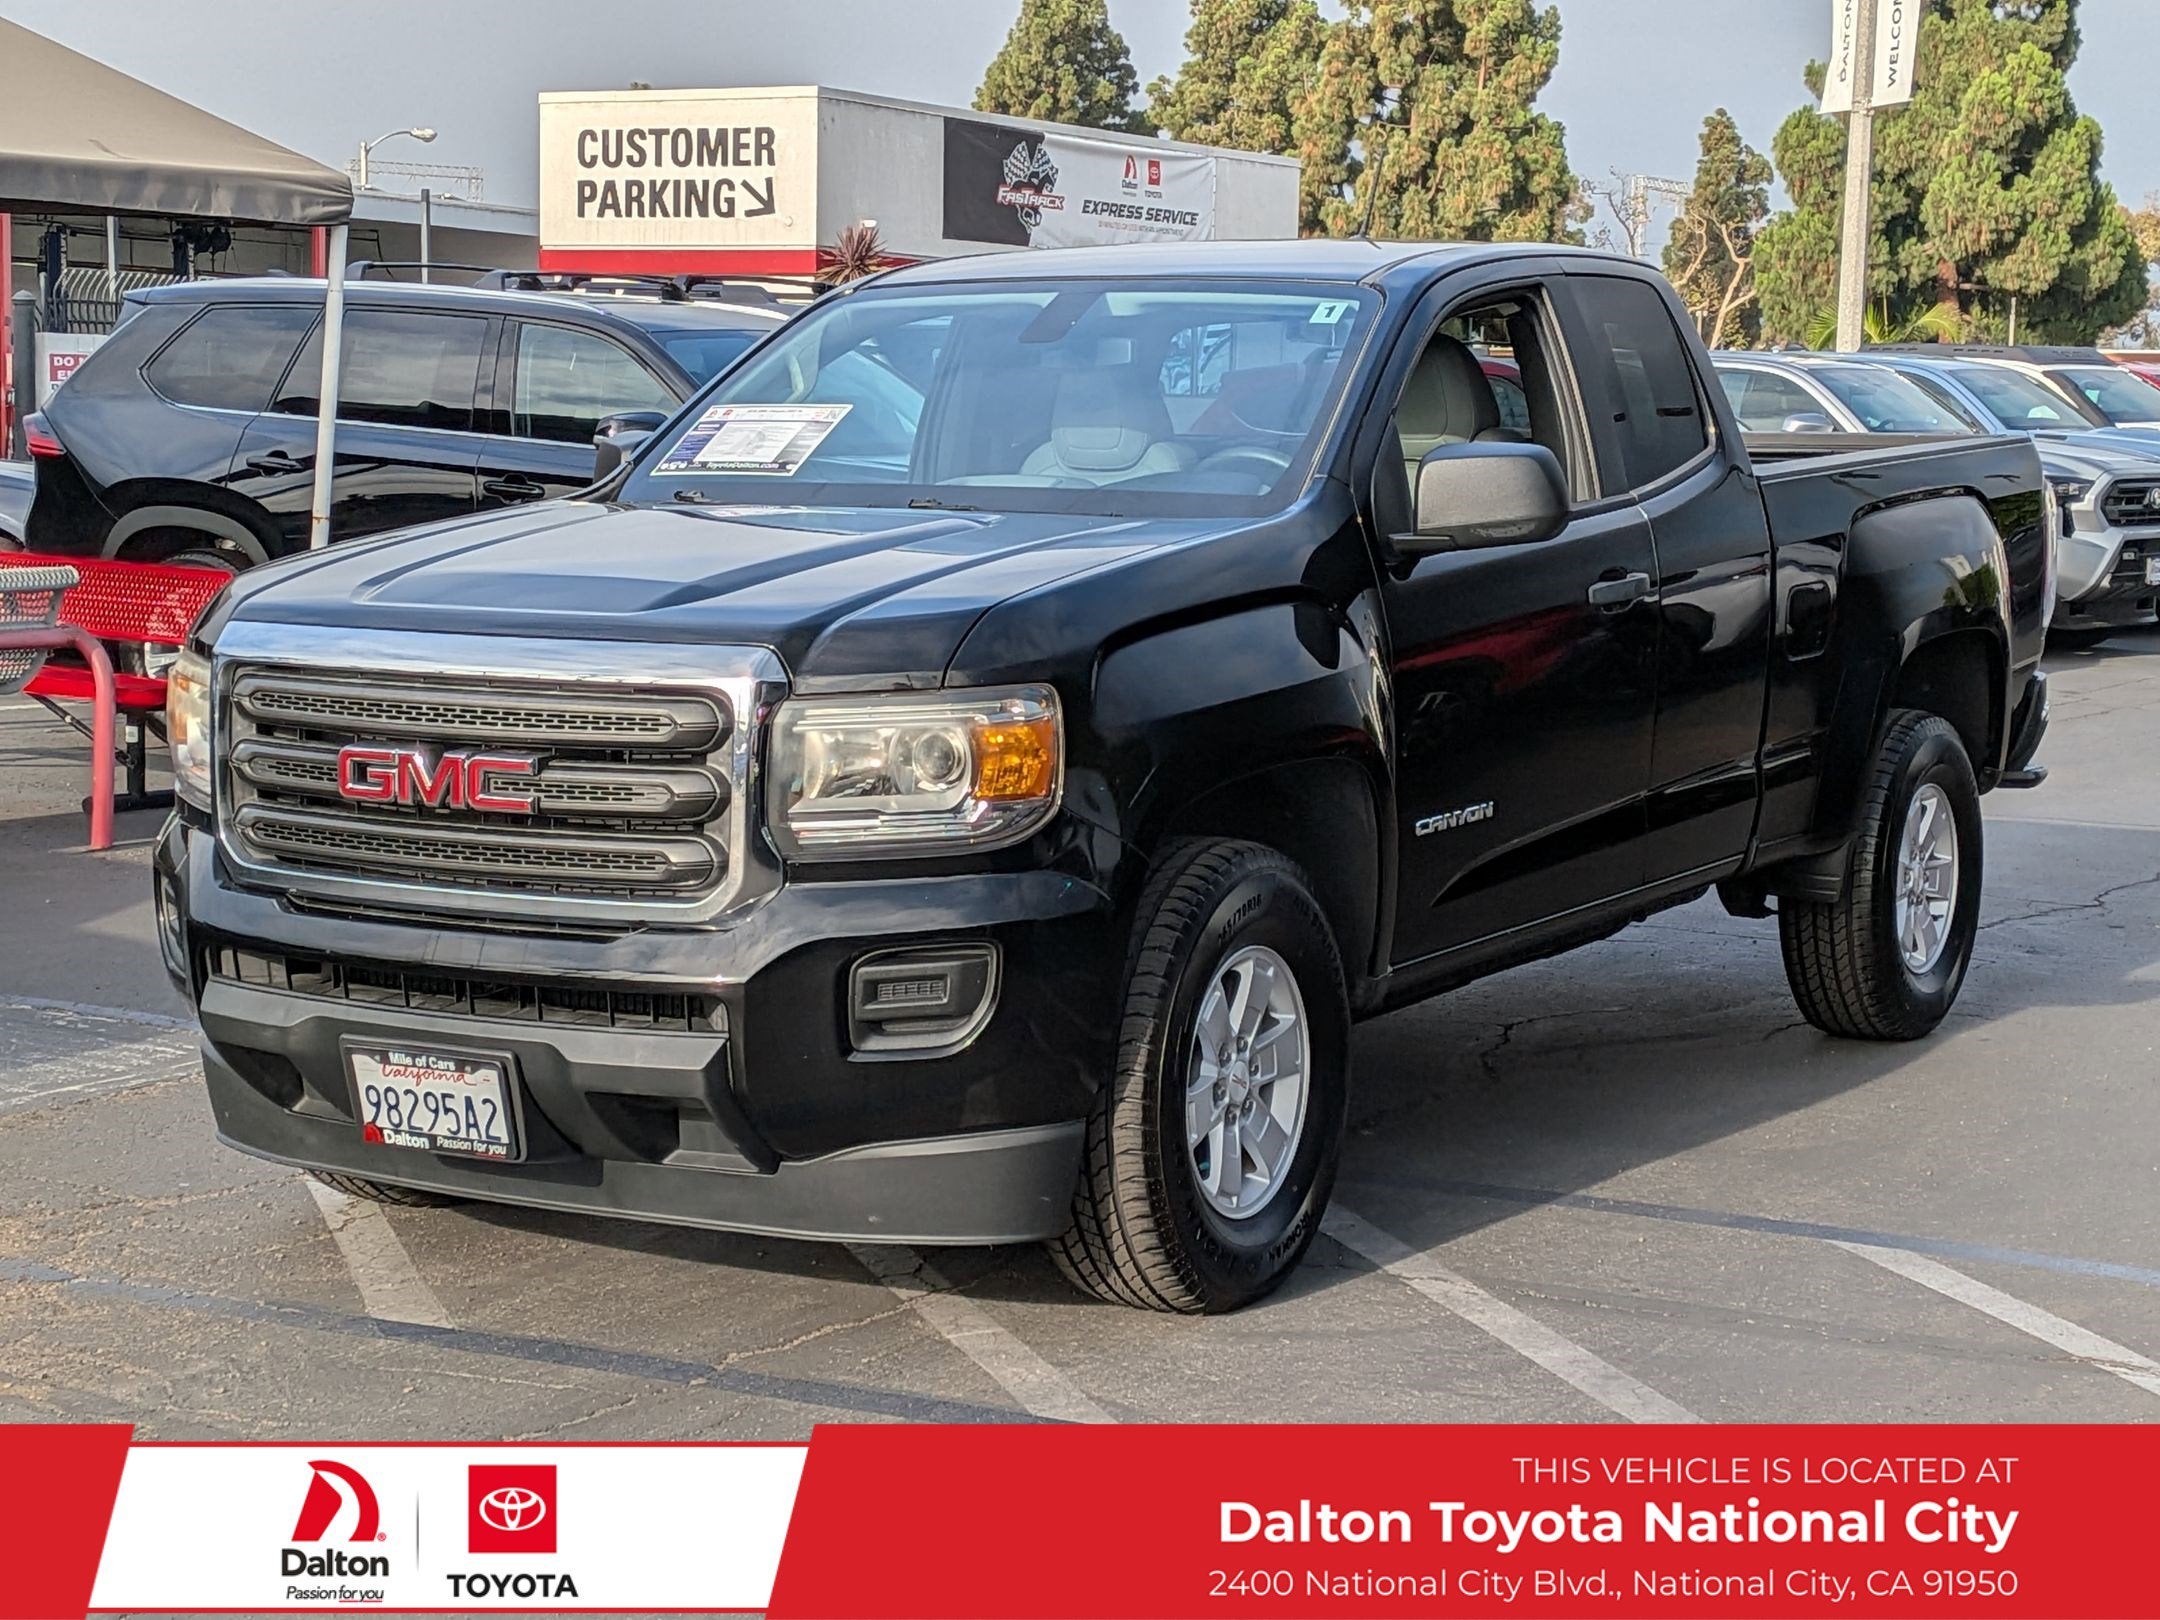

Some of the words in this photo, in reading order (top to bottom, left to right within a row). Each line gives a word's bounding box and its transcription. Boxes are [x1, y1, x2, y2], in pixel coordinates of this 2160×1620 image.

[578, 127, 776, 169] CUSTOMER
[577, 178, 735, 219] PARKING
[1081, 199, 1144, 220] EXPRESS
[1145, 207, 1199, 226] SERVICE
[1324, 305, 1337, 318] 1
[53, 356, 75, 367] DO
[337, 745, 537, 815] GMC
[1415, 801, 1494, 836] CANYON
[388, 1052, 413, 1066] Mile
[415, 1055, 427, 1067] of
[428, 1056, 456, 1071] Cars
[382, 1064, 477, 1087] California
[365, 1085, 501, 1141] 98295A2
[382, 1128, 430, 1150] Dalton
[436, 1136, 472, 1151] Passion
[473, 1140, 487, 1153] for
[488, 1143, 507, 1156] you
